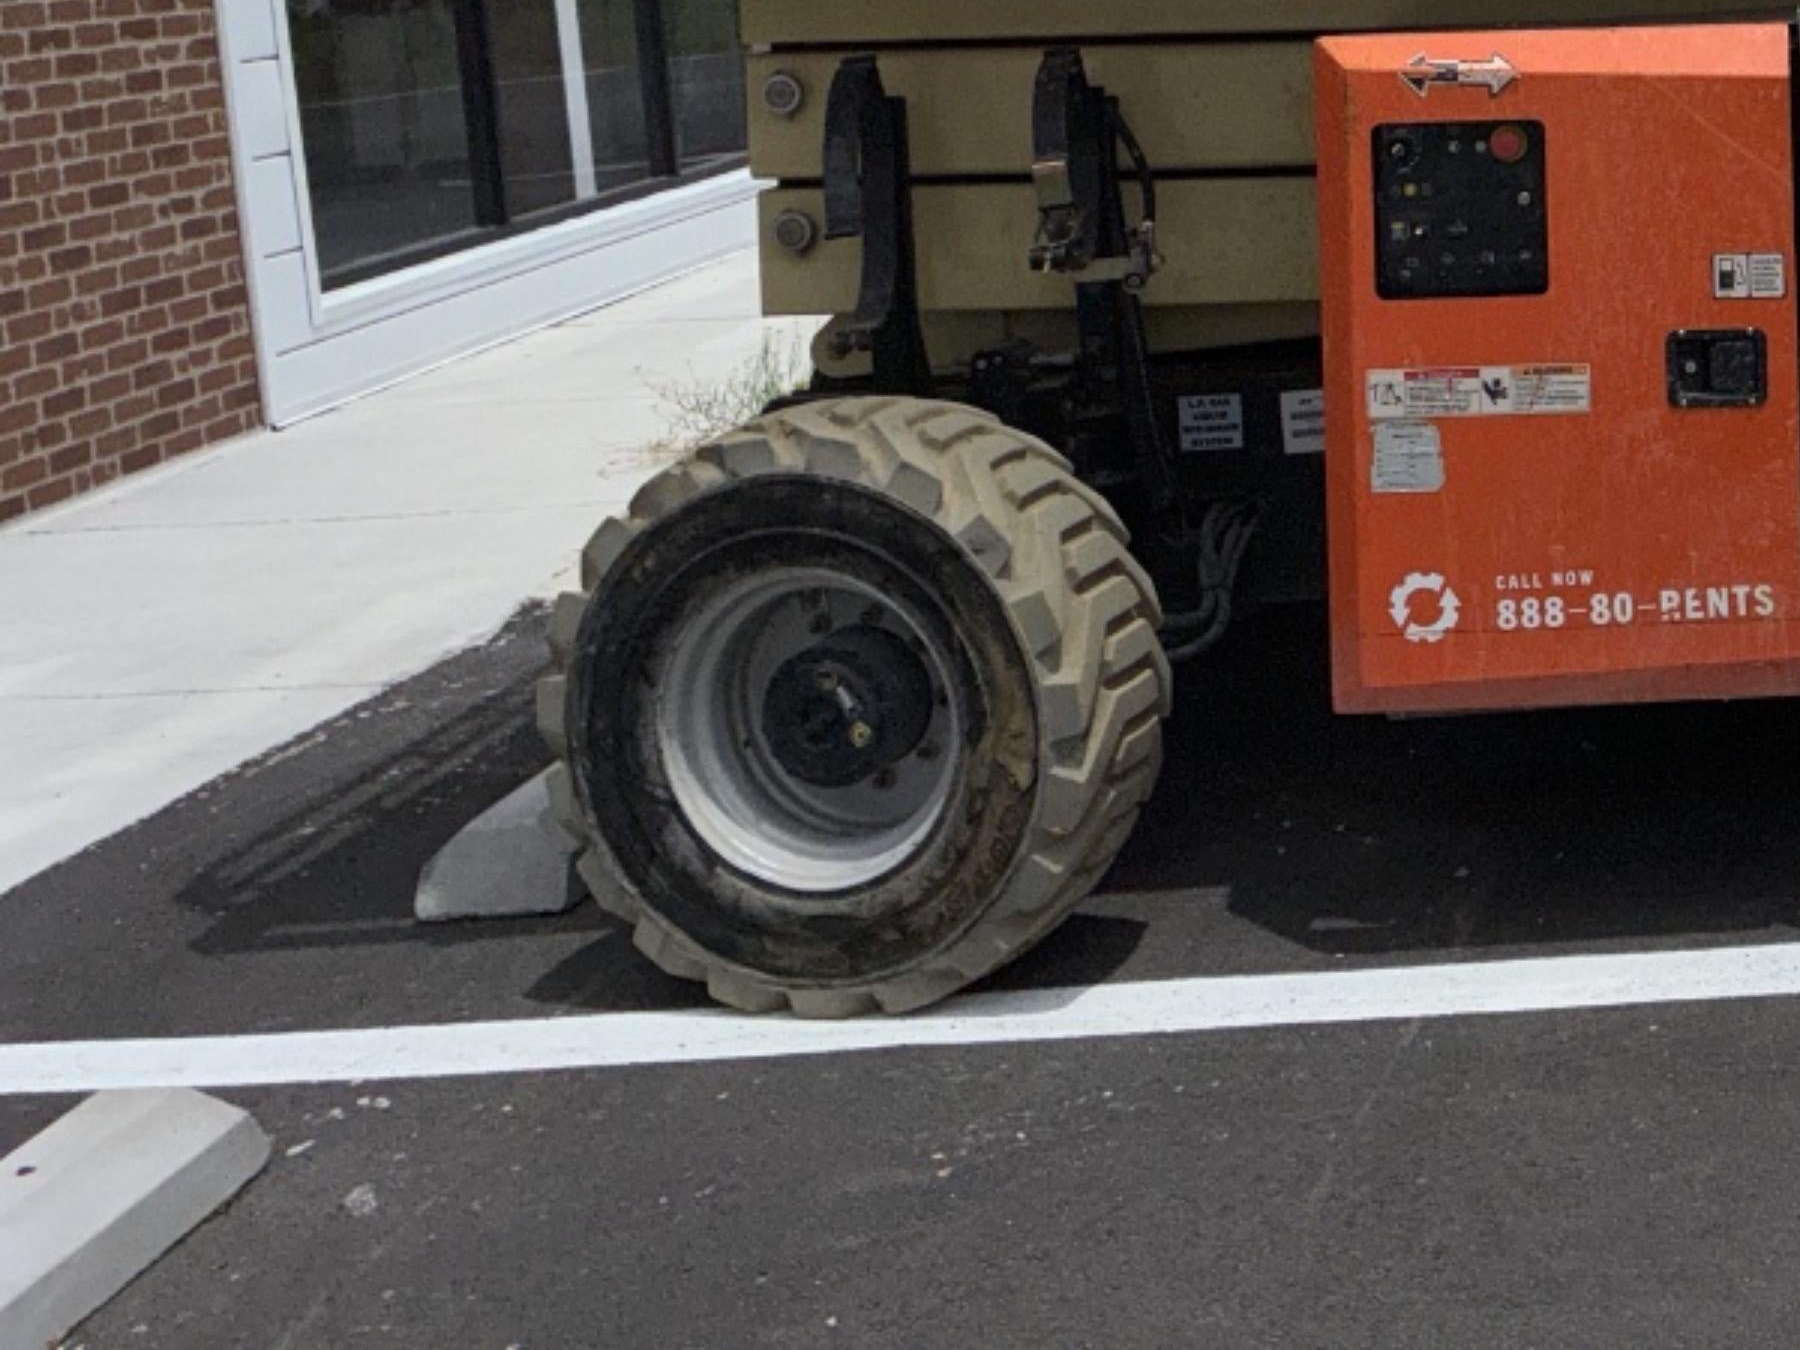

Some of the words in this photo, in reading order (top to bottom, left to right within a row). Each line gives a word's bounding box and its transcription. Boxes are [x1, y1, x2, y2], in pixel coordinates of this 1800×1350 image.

[1495, 572, 1543, 589] CALL
[1551, 569, 1594, 587] NOW
[1495, 583, 1775, 631] 888-80-RENTS
